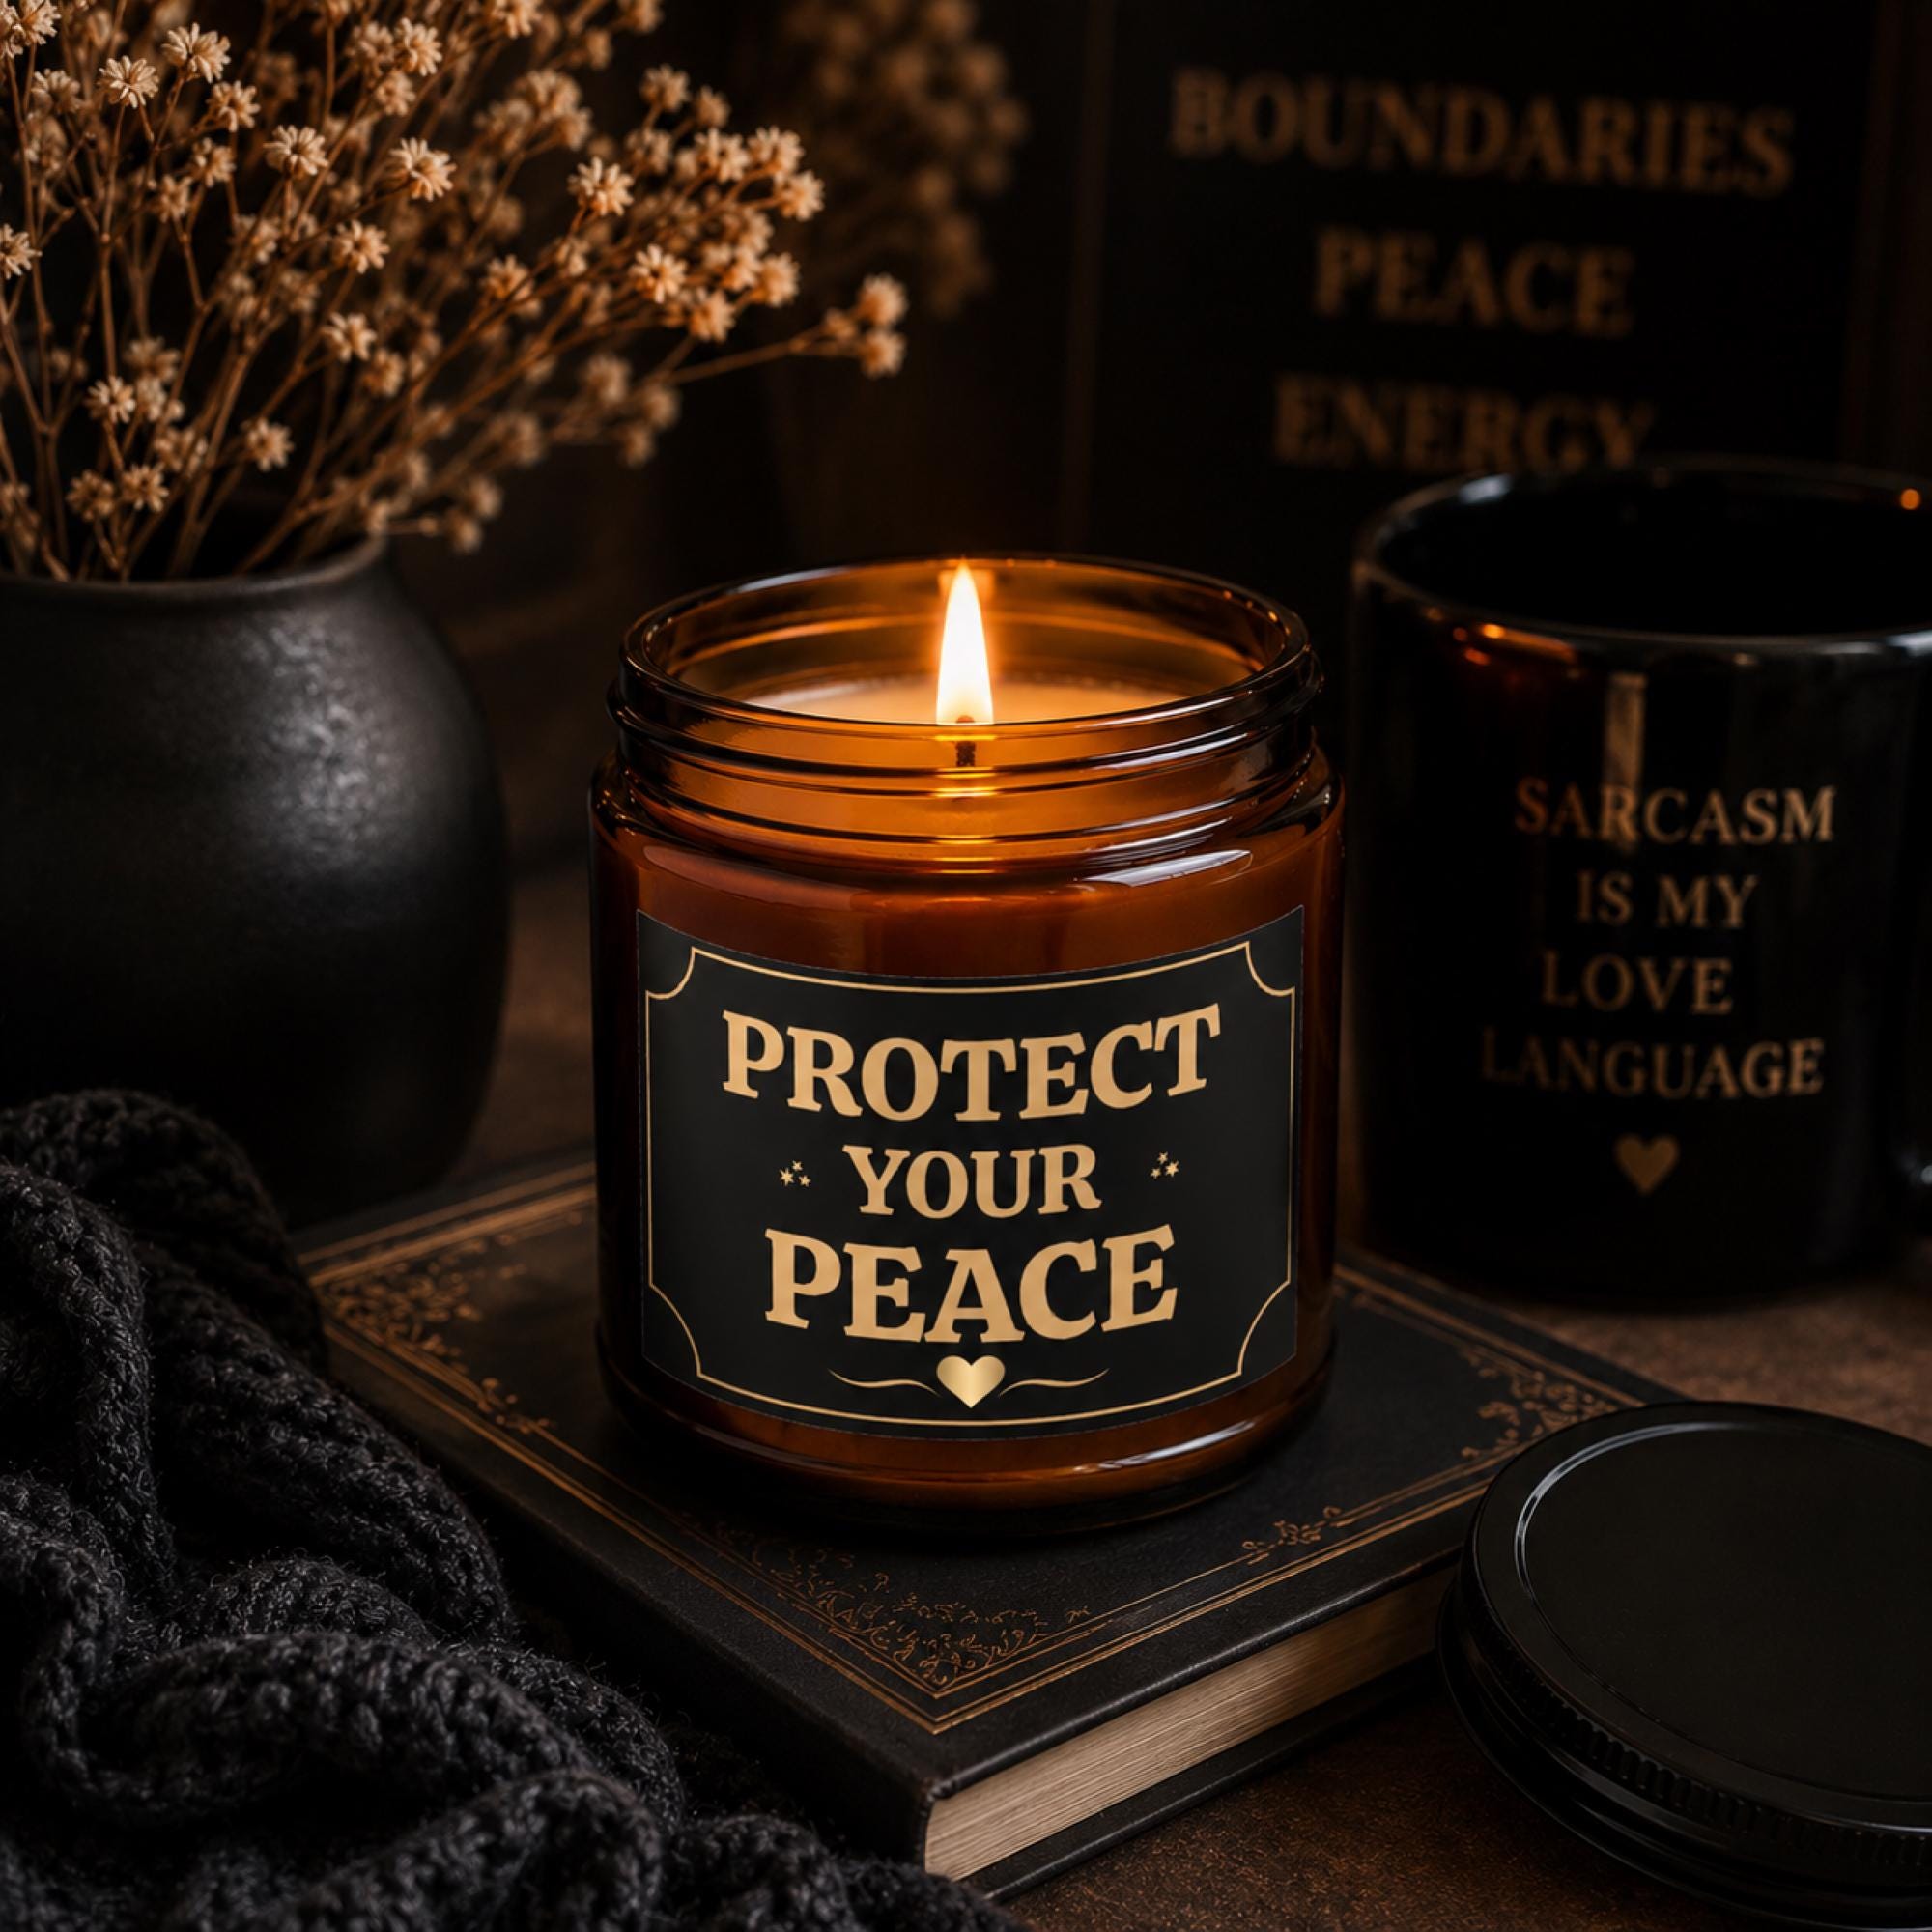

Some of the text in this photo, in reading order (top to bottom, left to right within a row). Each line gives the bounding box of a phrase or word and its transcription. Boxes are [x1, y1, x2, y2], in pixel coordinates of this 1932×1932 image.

[1170, 65, 1796, 199] BOUNDARIES
[1313, 221, 1637, 338] PEACE
[1273, 370, 1659, 475] ENERGY
[1514, 775, 1837, 846] SARCASM
[1576, 867, 1760, 929] IS MY
[1539, 946, 1734, 1016] LOVE
[722, 1003, 1221, 1122] PROTECT
[1479, 1021, 1825, 1100] LANGUAGE
[842, 1143, 1102, 1219] YOUR
[764, 1224, 1178, 1343] PEACE
